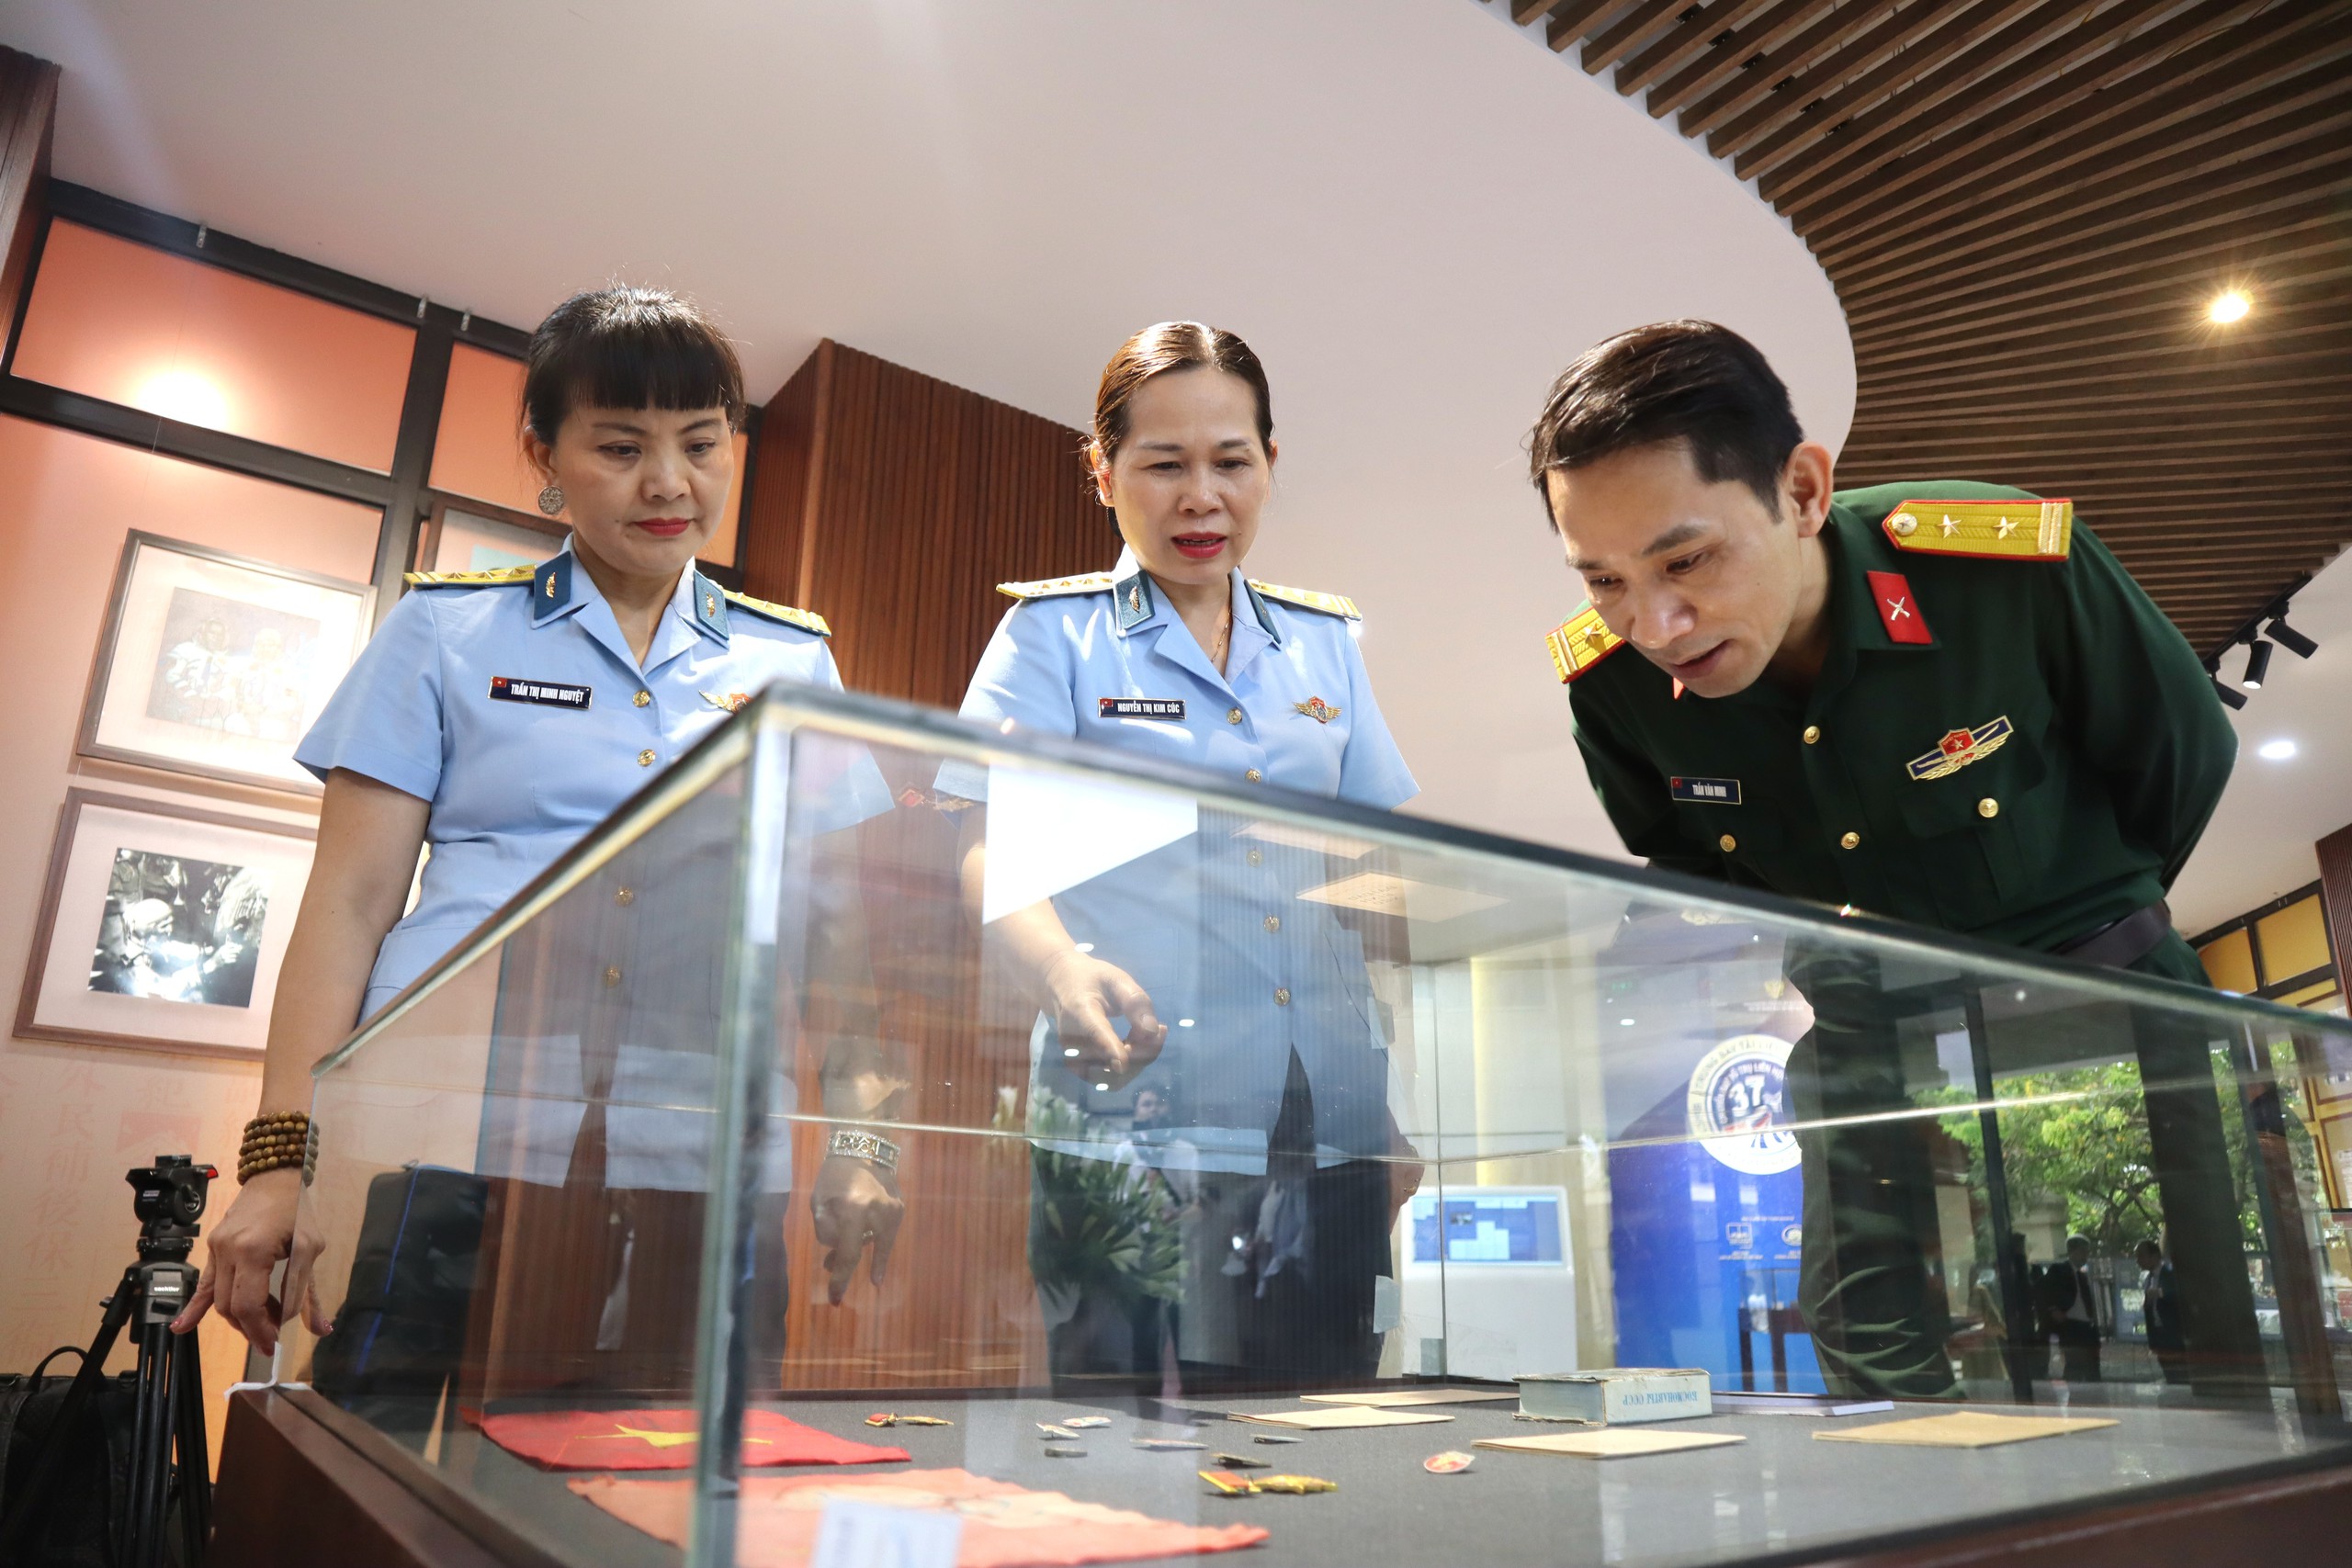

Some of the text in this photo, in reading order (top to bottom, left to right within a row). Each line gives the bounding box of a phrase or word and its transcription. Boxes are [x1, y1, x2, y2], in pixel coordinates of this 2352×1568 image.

[529, 686, 540, 700] THỊ
[540, 687, 559, 699] MINH
[559, 689, 584, 704] NGUYỆT
[1143, 704, 1152, 715] THỊ
[1153, 704, 1166, 713] KIM
[1167, 702, 1180, 713] CÚC
[1622, 1393, 1645, 1406] СССР
